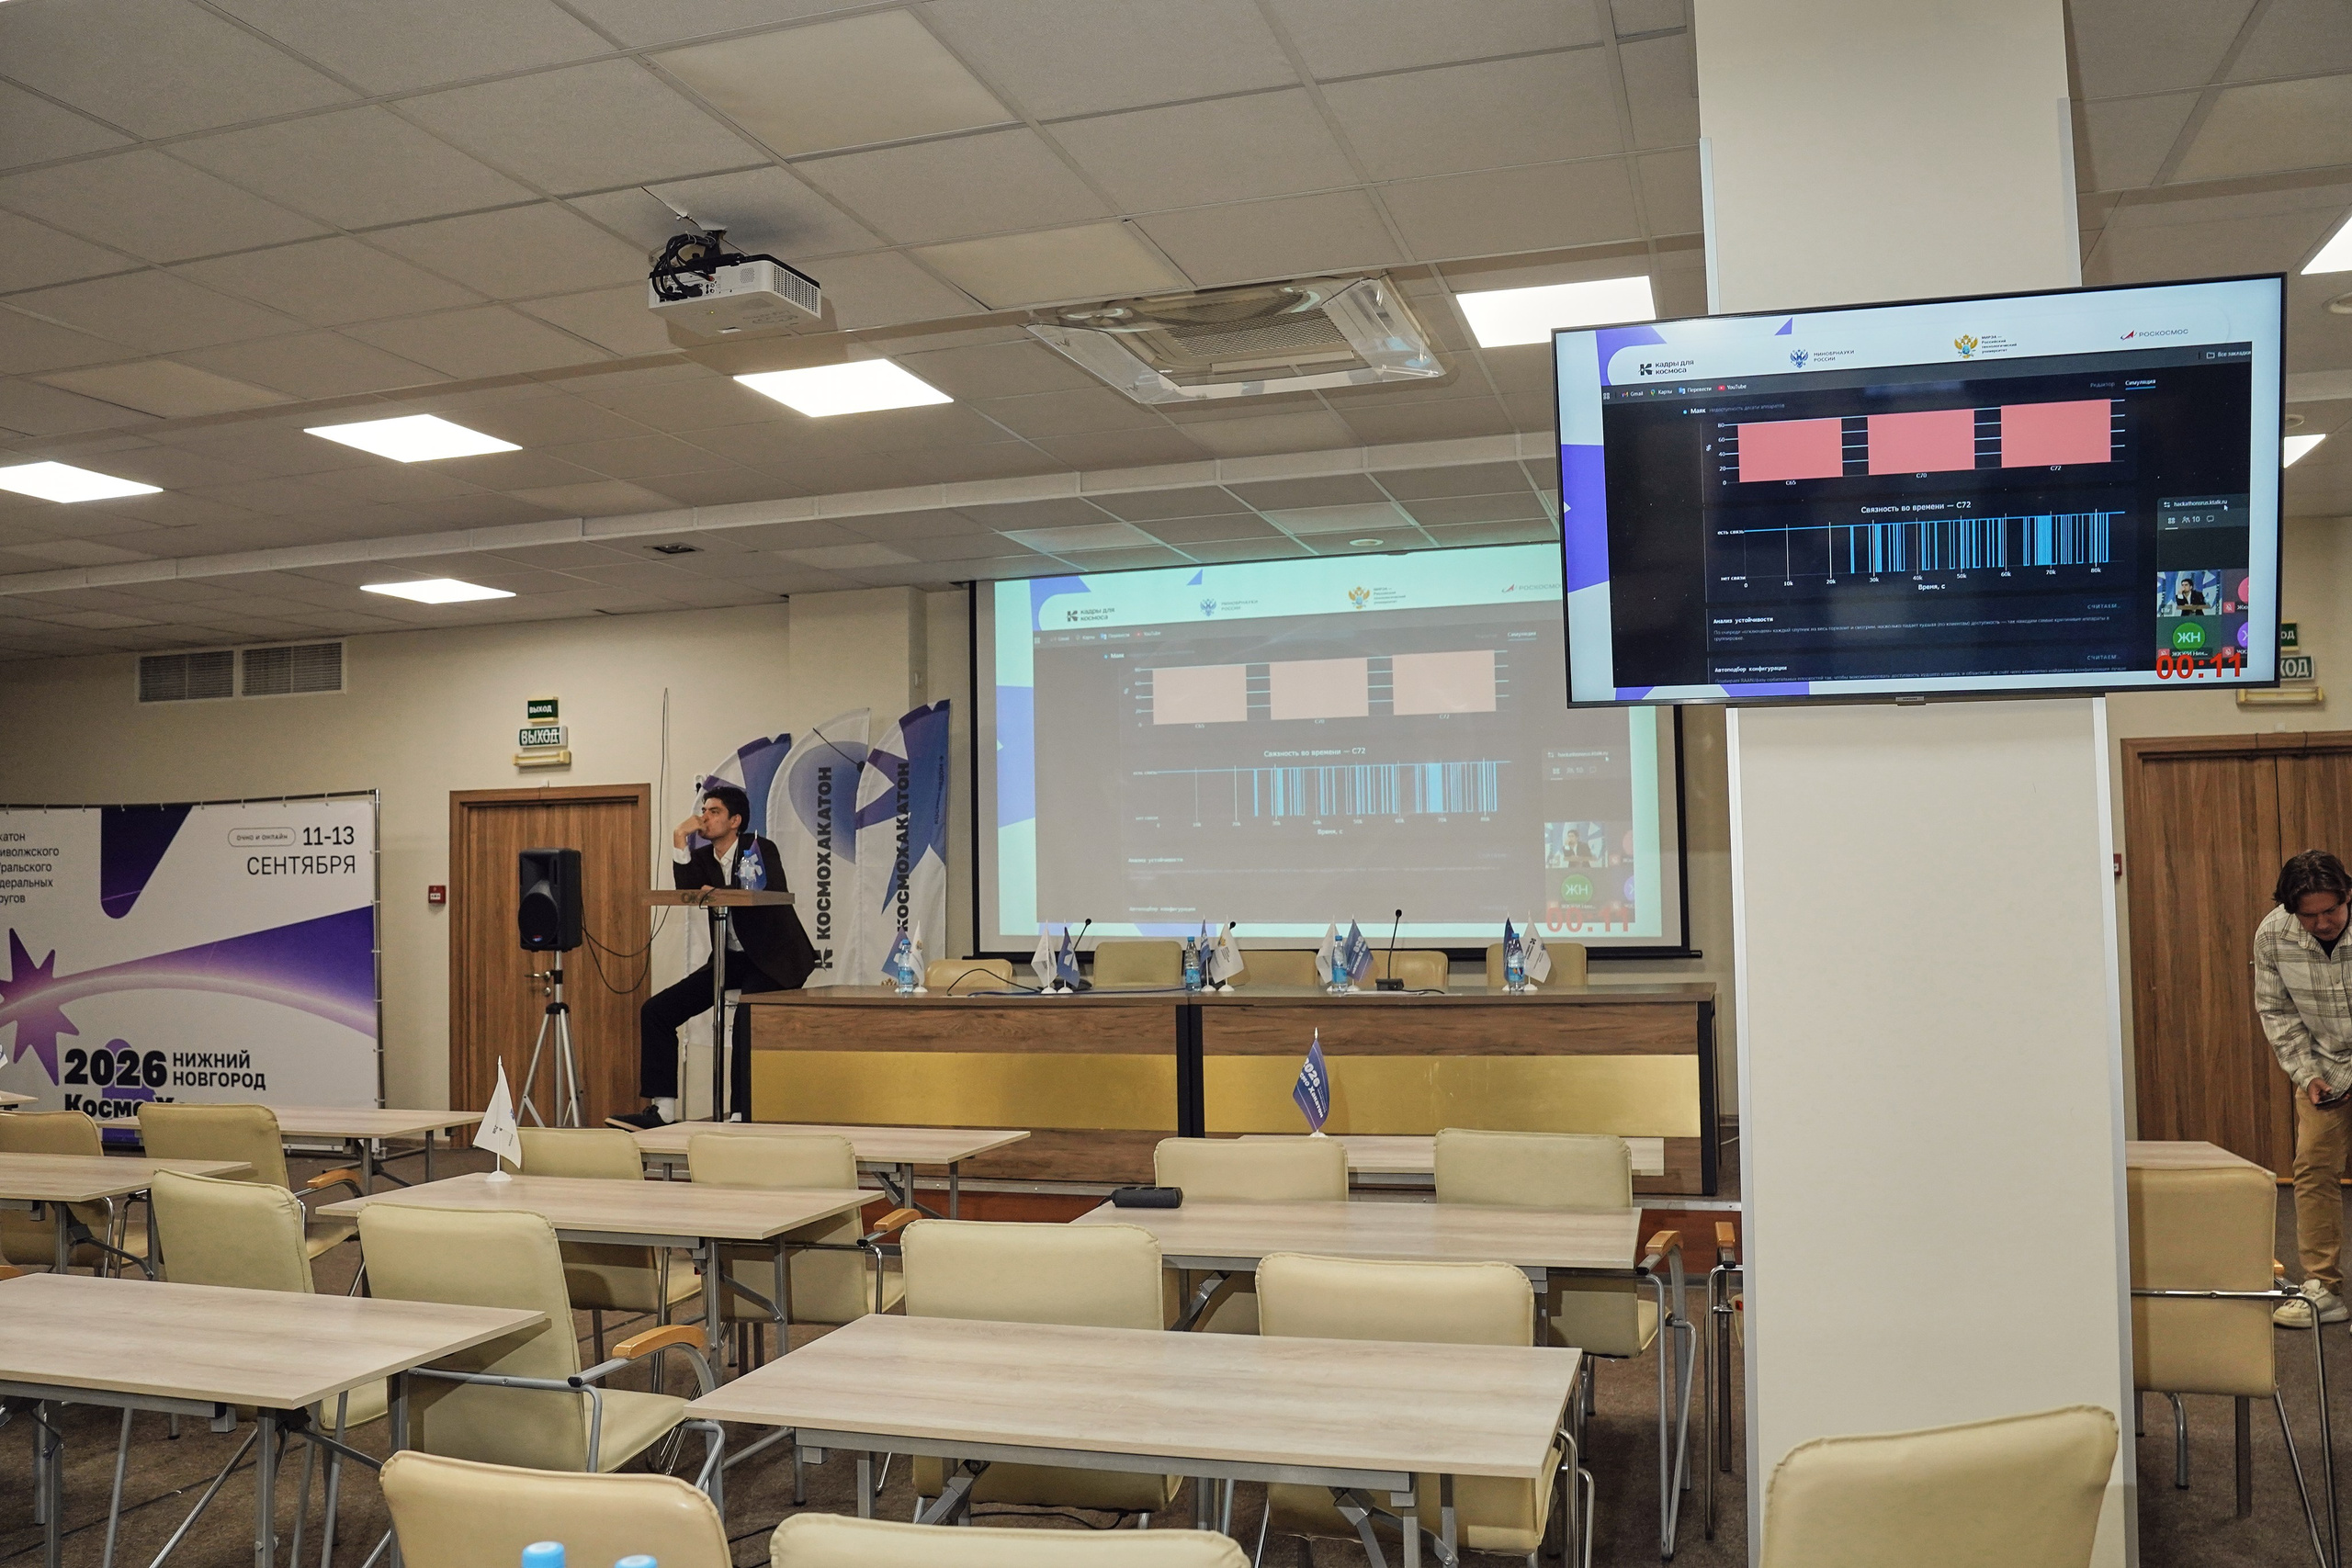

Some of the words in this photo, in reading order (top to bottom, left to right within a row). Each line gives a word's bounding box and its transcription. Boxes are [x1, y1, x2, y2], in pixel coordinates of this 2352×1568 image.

[2139, 328, 2188, 338] РОСКОСМОС
[1813, 349, 1855, 357] МИНОБРНАУКИ
[1655, 360, 1679, 369] кадры
[1680, 359, 1694, 367] для
[2125, 378, 2156, 387] Симуляция
[1687, 386, 1713, 394] Перевести
[1860, 505, 1899, 514] Связность
[1913, 503, 1945, 513] времени
[1102, 606, 1115, 615] для
[1735, 616, 1774, 625] устойчивости
[2177, 631, 2201, 643] ЖН
[1748, 664, 1787, 673] конфигурации
[2156, 652, 2241, 681] 00:11
[529, 705, 552, 714] ВЫХОД
[521, 728, 560, 745] ВЫХОД
[1263, 749, 1300, 758] Связность
[1311, 748, 1341, 757] времени
[303, 826, 355, 845] 11-13
[896, 762, 910, 931] КОСМОХАКАТОН
[817, 767, 832, 940] КОСМОХАКАТОН
[0, 863, 52, 874] ральского
[247, 855, 356, 875] СЕНТЯБРЯ
[1565, 884, 1589, 896] ЖН
[1545, 906, 1629, 932] 00:11
[173, 1049, 251, 1069] НИЖНИЙ
[64, 1048, 168, 1088] 2026
[173, 1071, 266, 1090] НОВГОРОД
